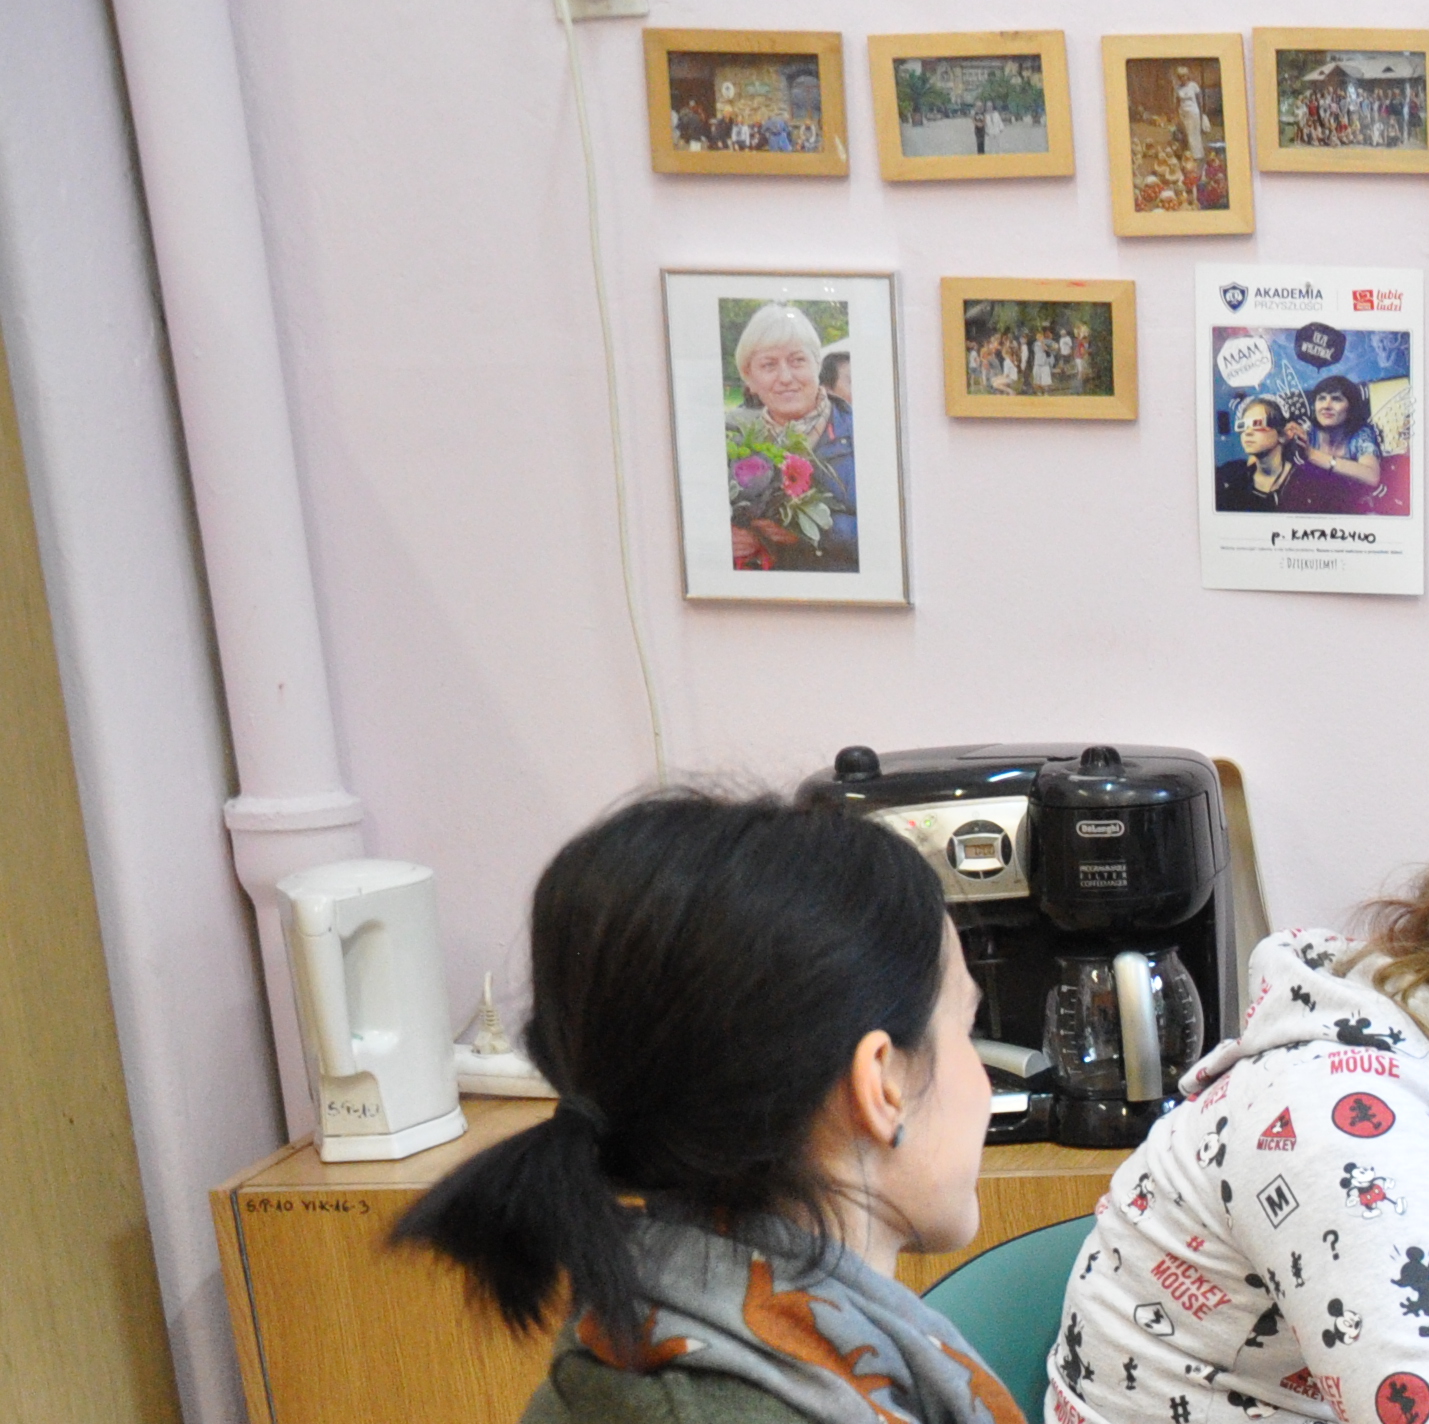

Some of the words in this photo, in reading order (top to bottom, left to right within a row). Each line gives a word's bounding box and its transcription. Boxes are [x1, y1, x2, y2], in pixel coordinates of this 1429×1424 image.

[1254, 287, 1323, 300] AKADEMIA
[1254, 300, 1323, 312] PRZYSZŁOŚCI
[1222, 341, 1264, 370] MAM
[1330, 1054, 1401, 1079] MOUSE
[1256, 1137, 1297, 1152] MICKEY
[1149, 1258, 1213, 1322] MOUSE
[1164, 1251, 1233, 1312] MICKEY
